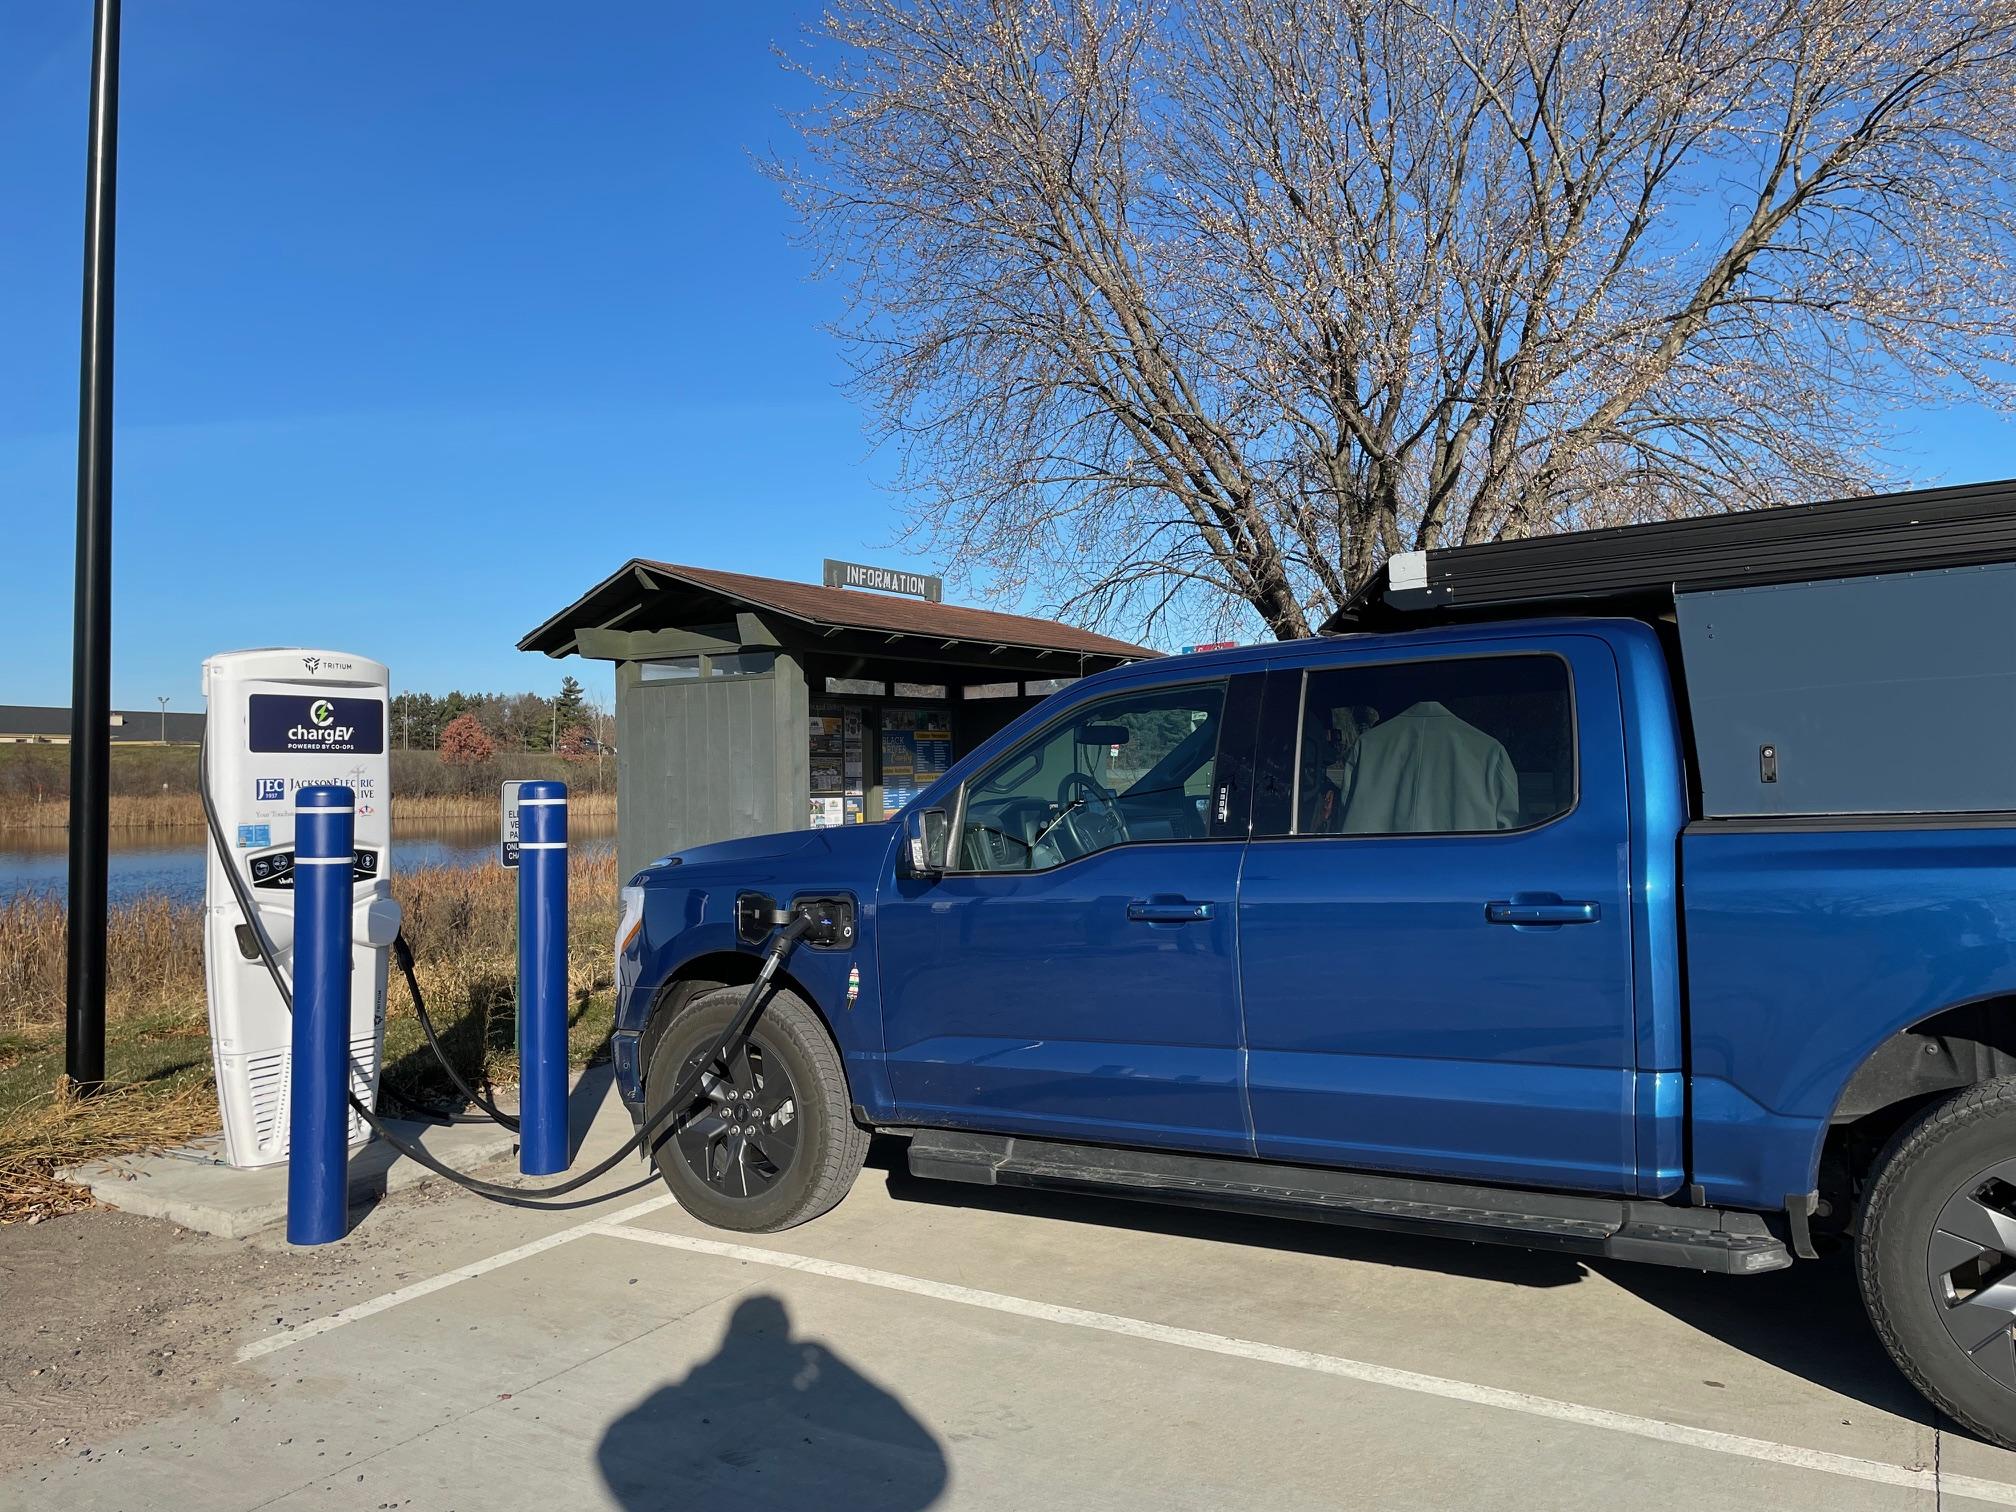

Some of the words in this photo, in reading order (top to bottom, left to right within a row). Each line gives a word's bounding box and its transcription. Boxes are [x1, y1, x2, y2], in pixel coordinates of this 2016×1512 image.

[847, 565, 925, 595] INFORMATION
[323, 662, 352, 670] TRITIUM
[287, 724, 354, 744] chargEV
[258, 779, 284, 800] JEC
[506, 843, 519, 851] ONL
